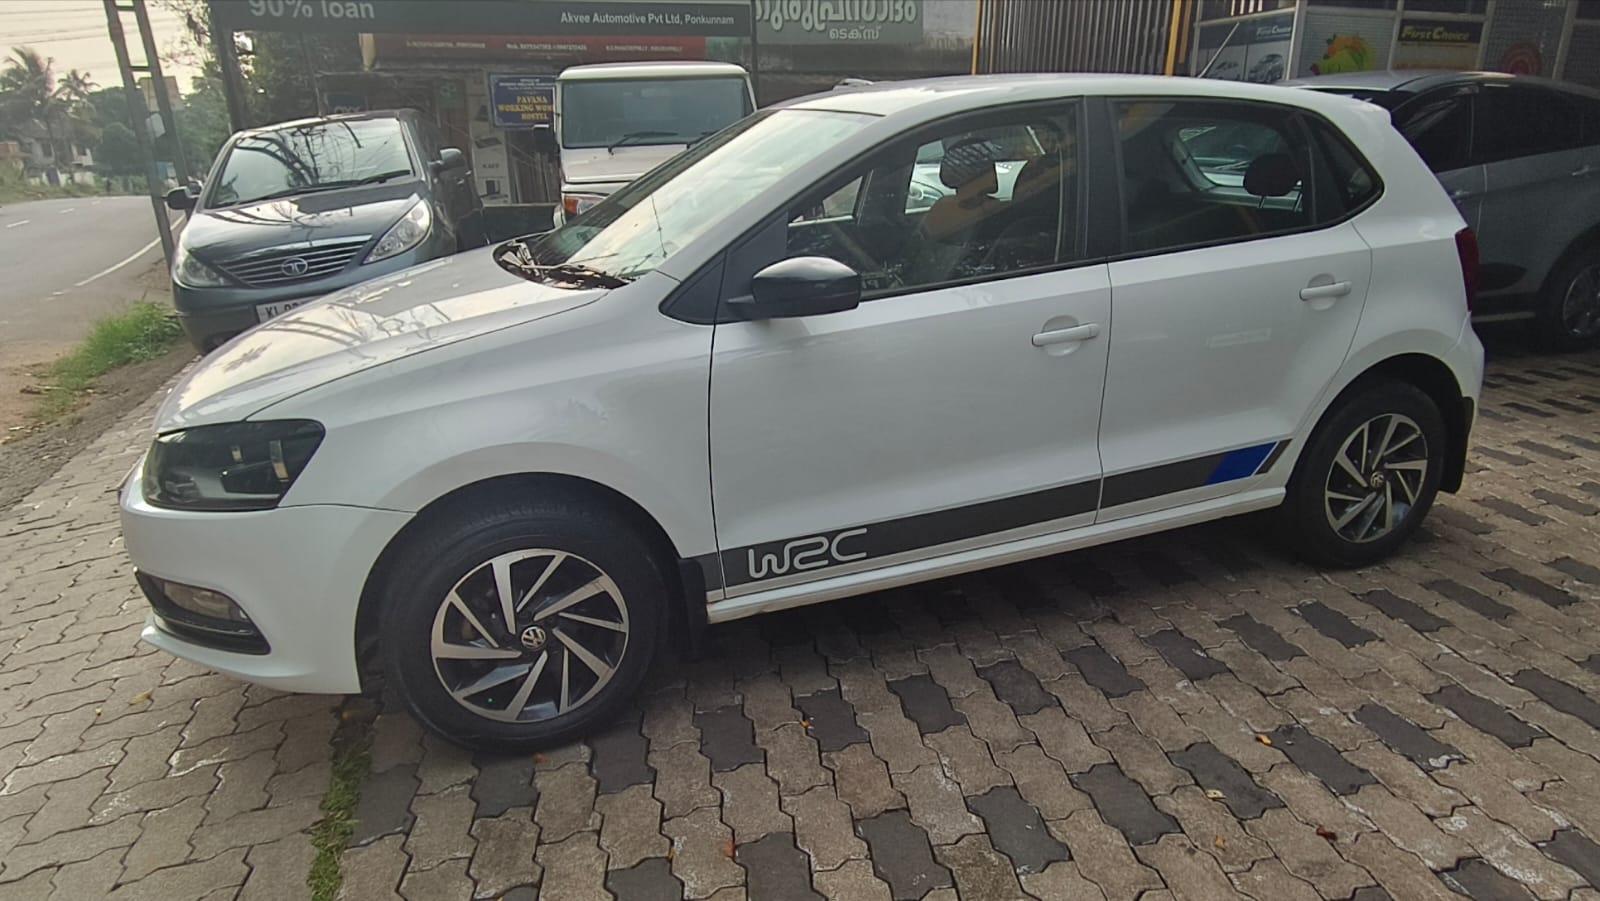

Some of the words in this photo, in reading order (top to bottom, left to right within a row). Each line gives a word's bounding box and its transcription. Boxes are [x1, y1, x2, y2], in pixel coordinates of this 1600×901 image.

[249, 0, 313, 18] 90%
[320, 0, 374, 18] loan
[561, 12, 590, 24] Akvee
[593, 12, 646, 24] Automotive
[648, 13, 663, 24] Pvt
[665, 13, 683, 25] Ltd,
[685, 14, 734, 25] Ponkunnam
[749, 528, 867, 578] WRC
